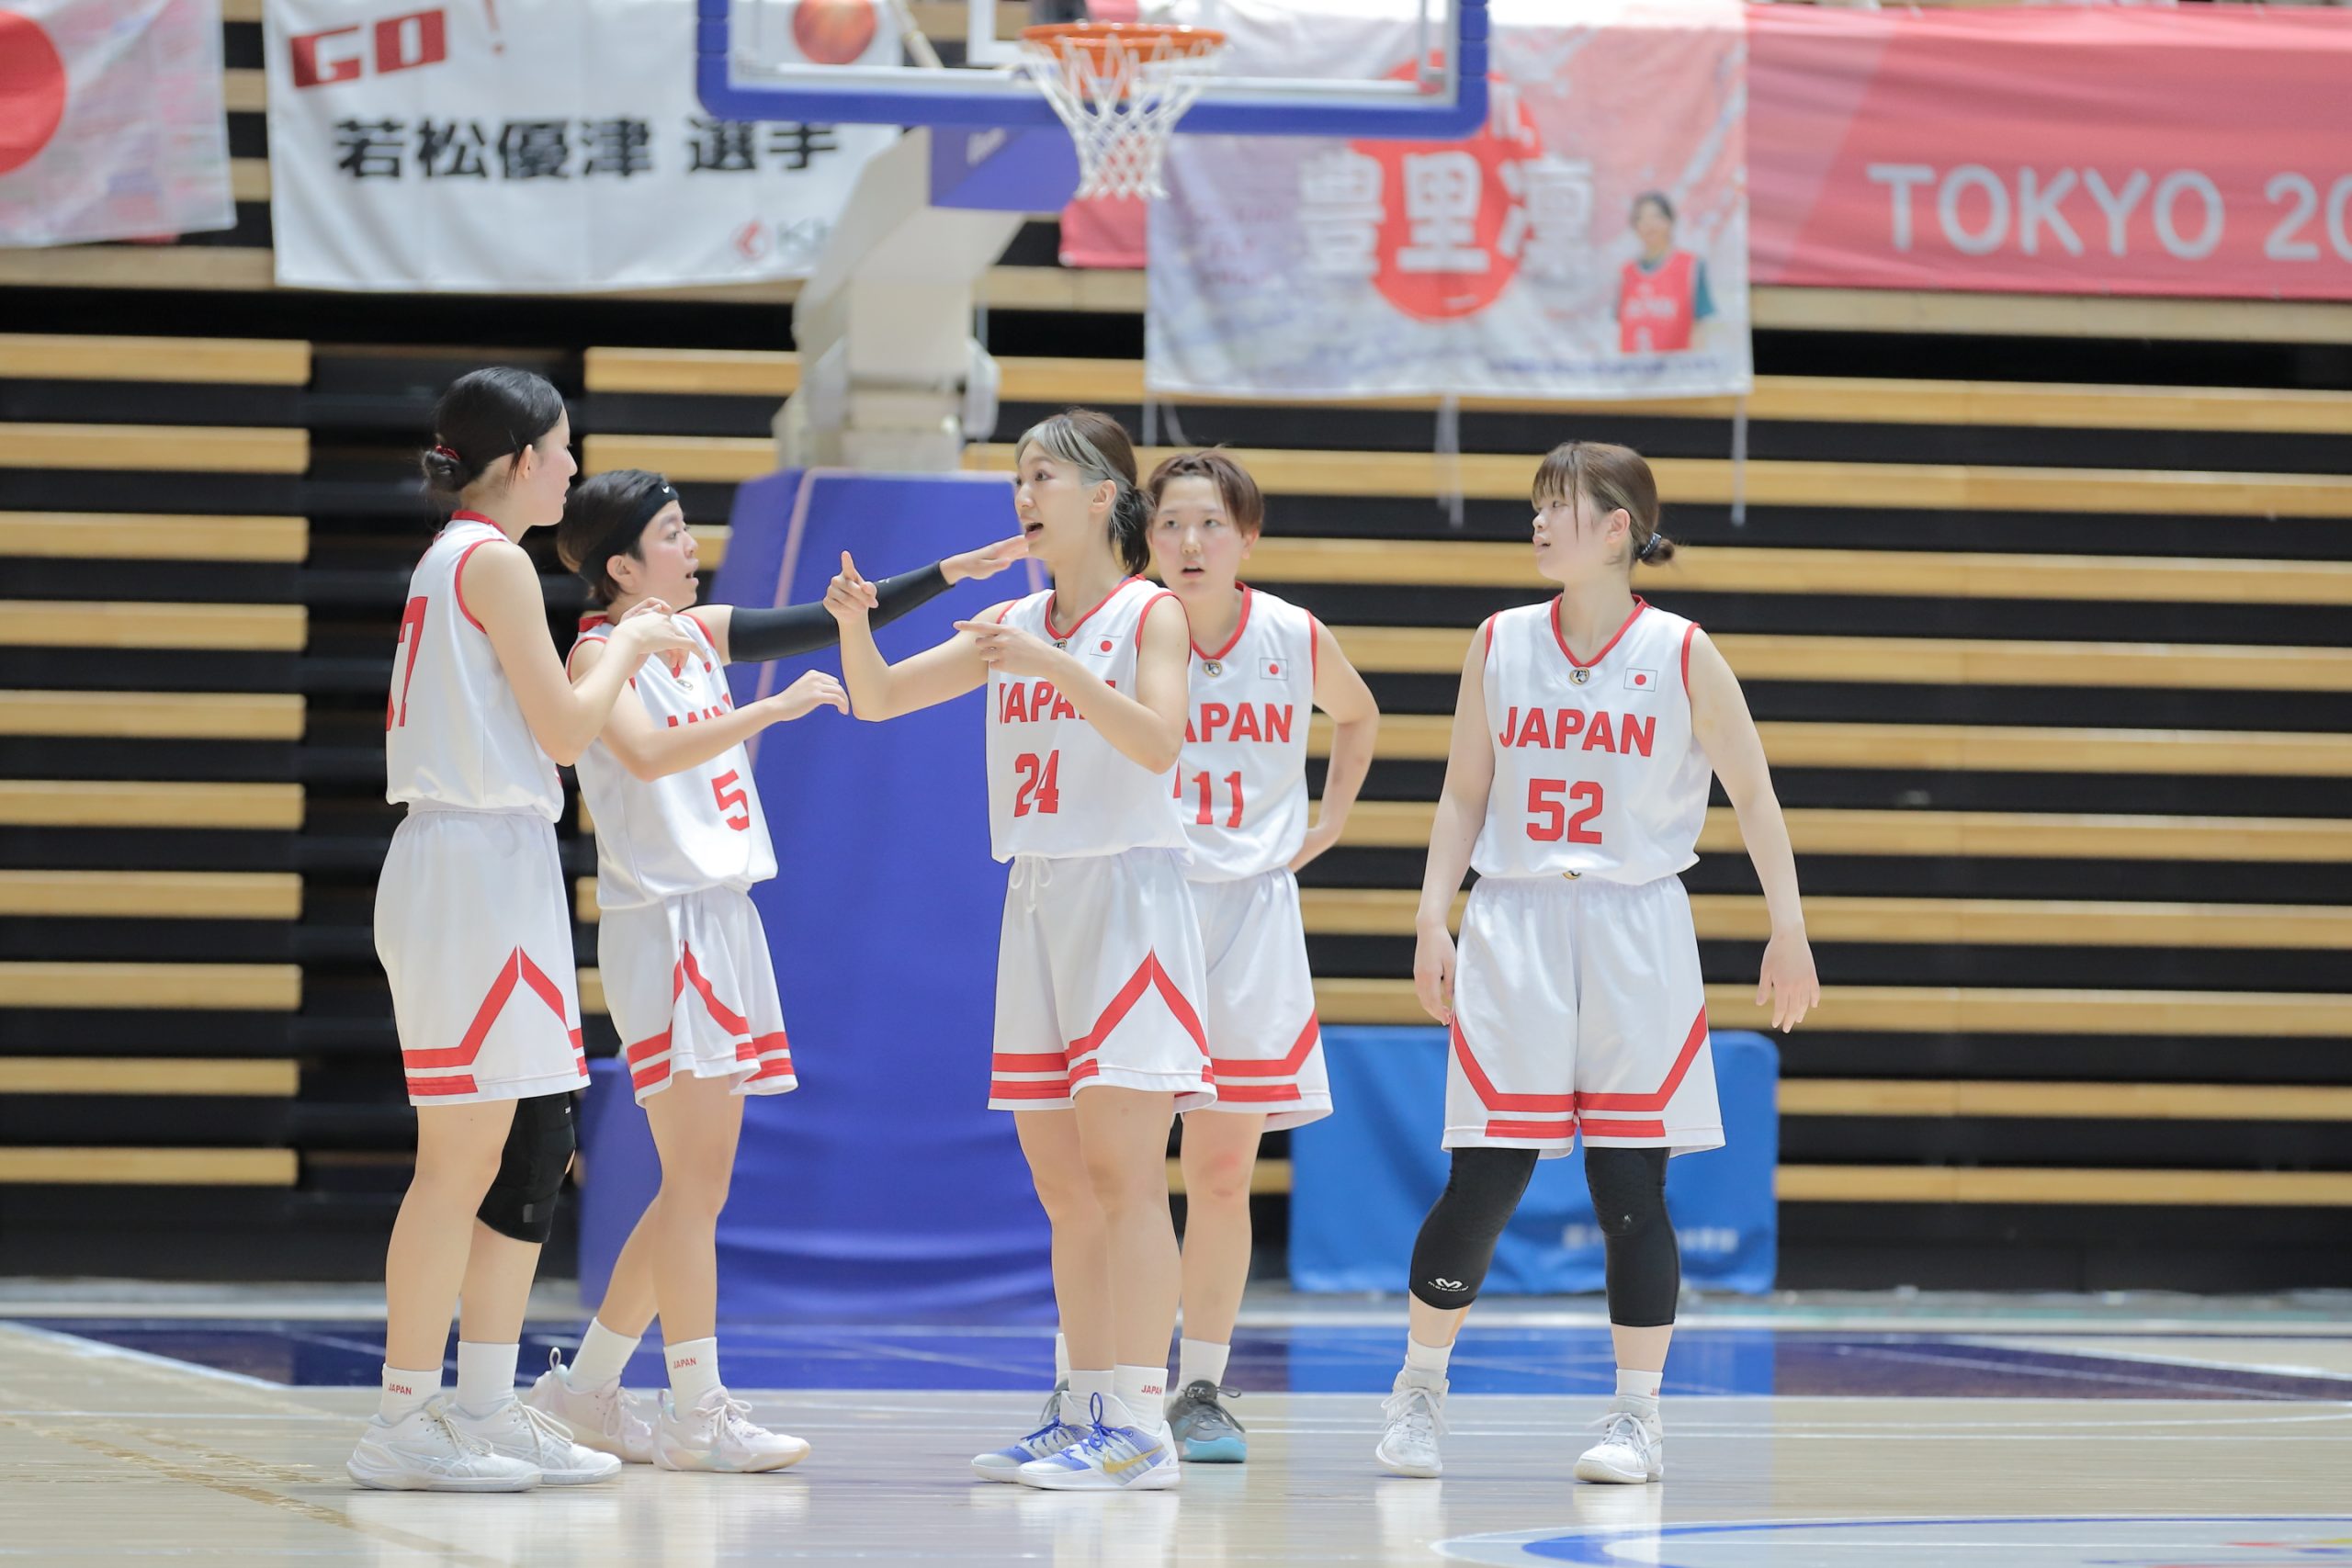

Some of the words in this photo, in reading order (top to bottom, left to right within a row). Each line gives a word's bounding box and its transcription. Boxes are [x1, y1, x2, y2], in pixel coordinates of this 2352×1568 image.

[336, 118, 654, 179] 若松優津
[687, 117, 838, 173] 選手
[1865, 163, 2226, 261] TOKYO
[386, 595, 429, 732] 7
[1498, 706, 1657, 758] JAPAN
[710, 769, 751, 832] 5
[1013, 750, 1060, 818] 24
[1192, 771, 1244, 829] 11
[1526, 778, 1604, 845] 52
[388, 1382, 413, 1395] JAPAN
[673, 1357, 697, 1369] JAPAN
[1140, 1384, 1163, 1395] JAPAN
